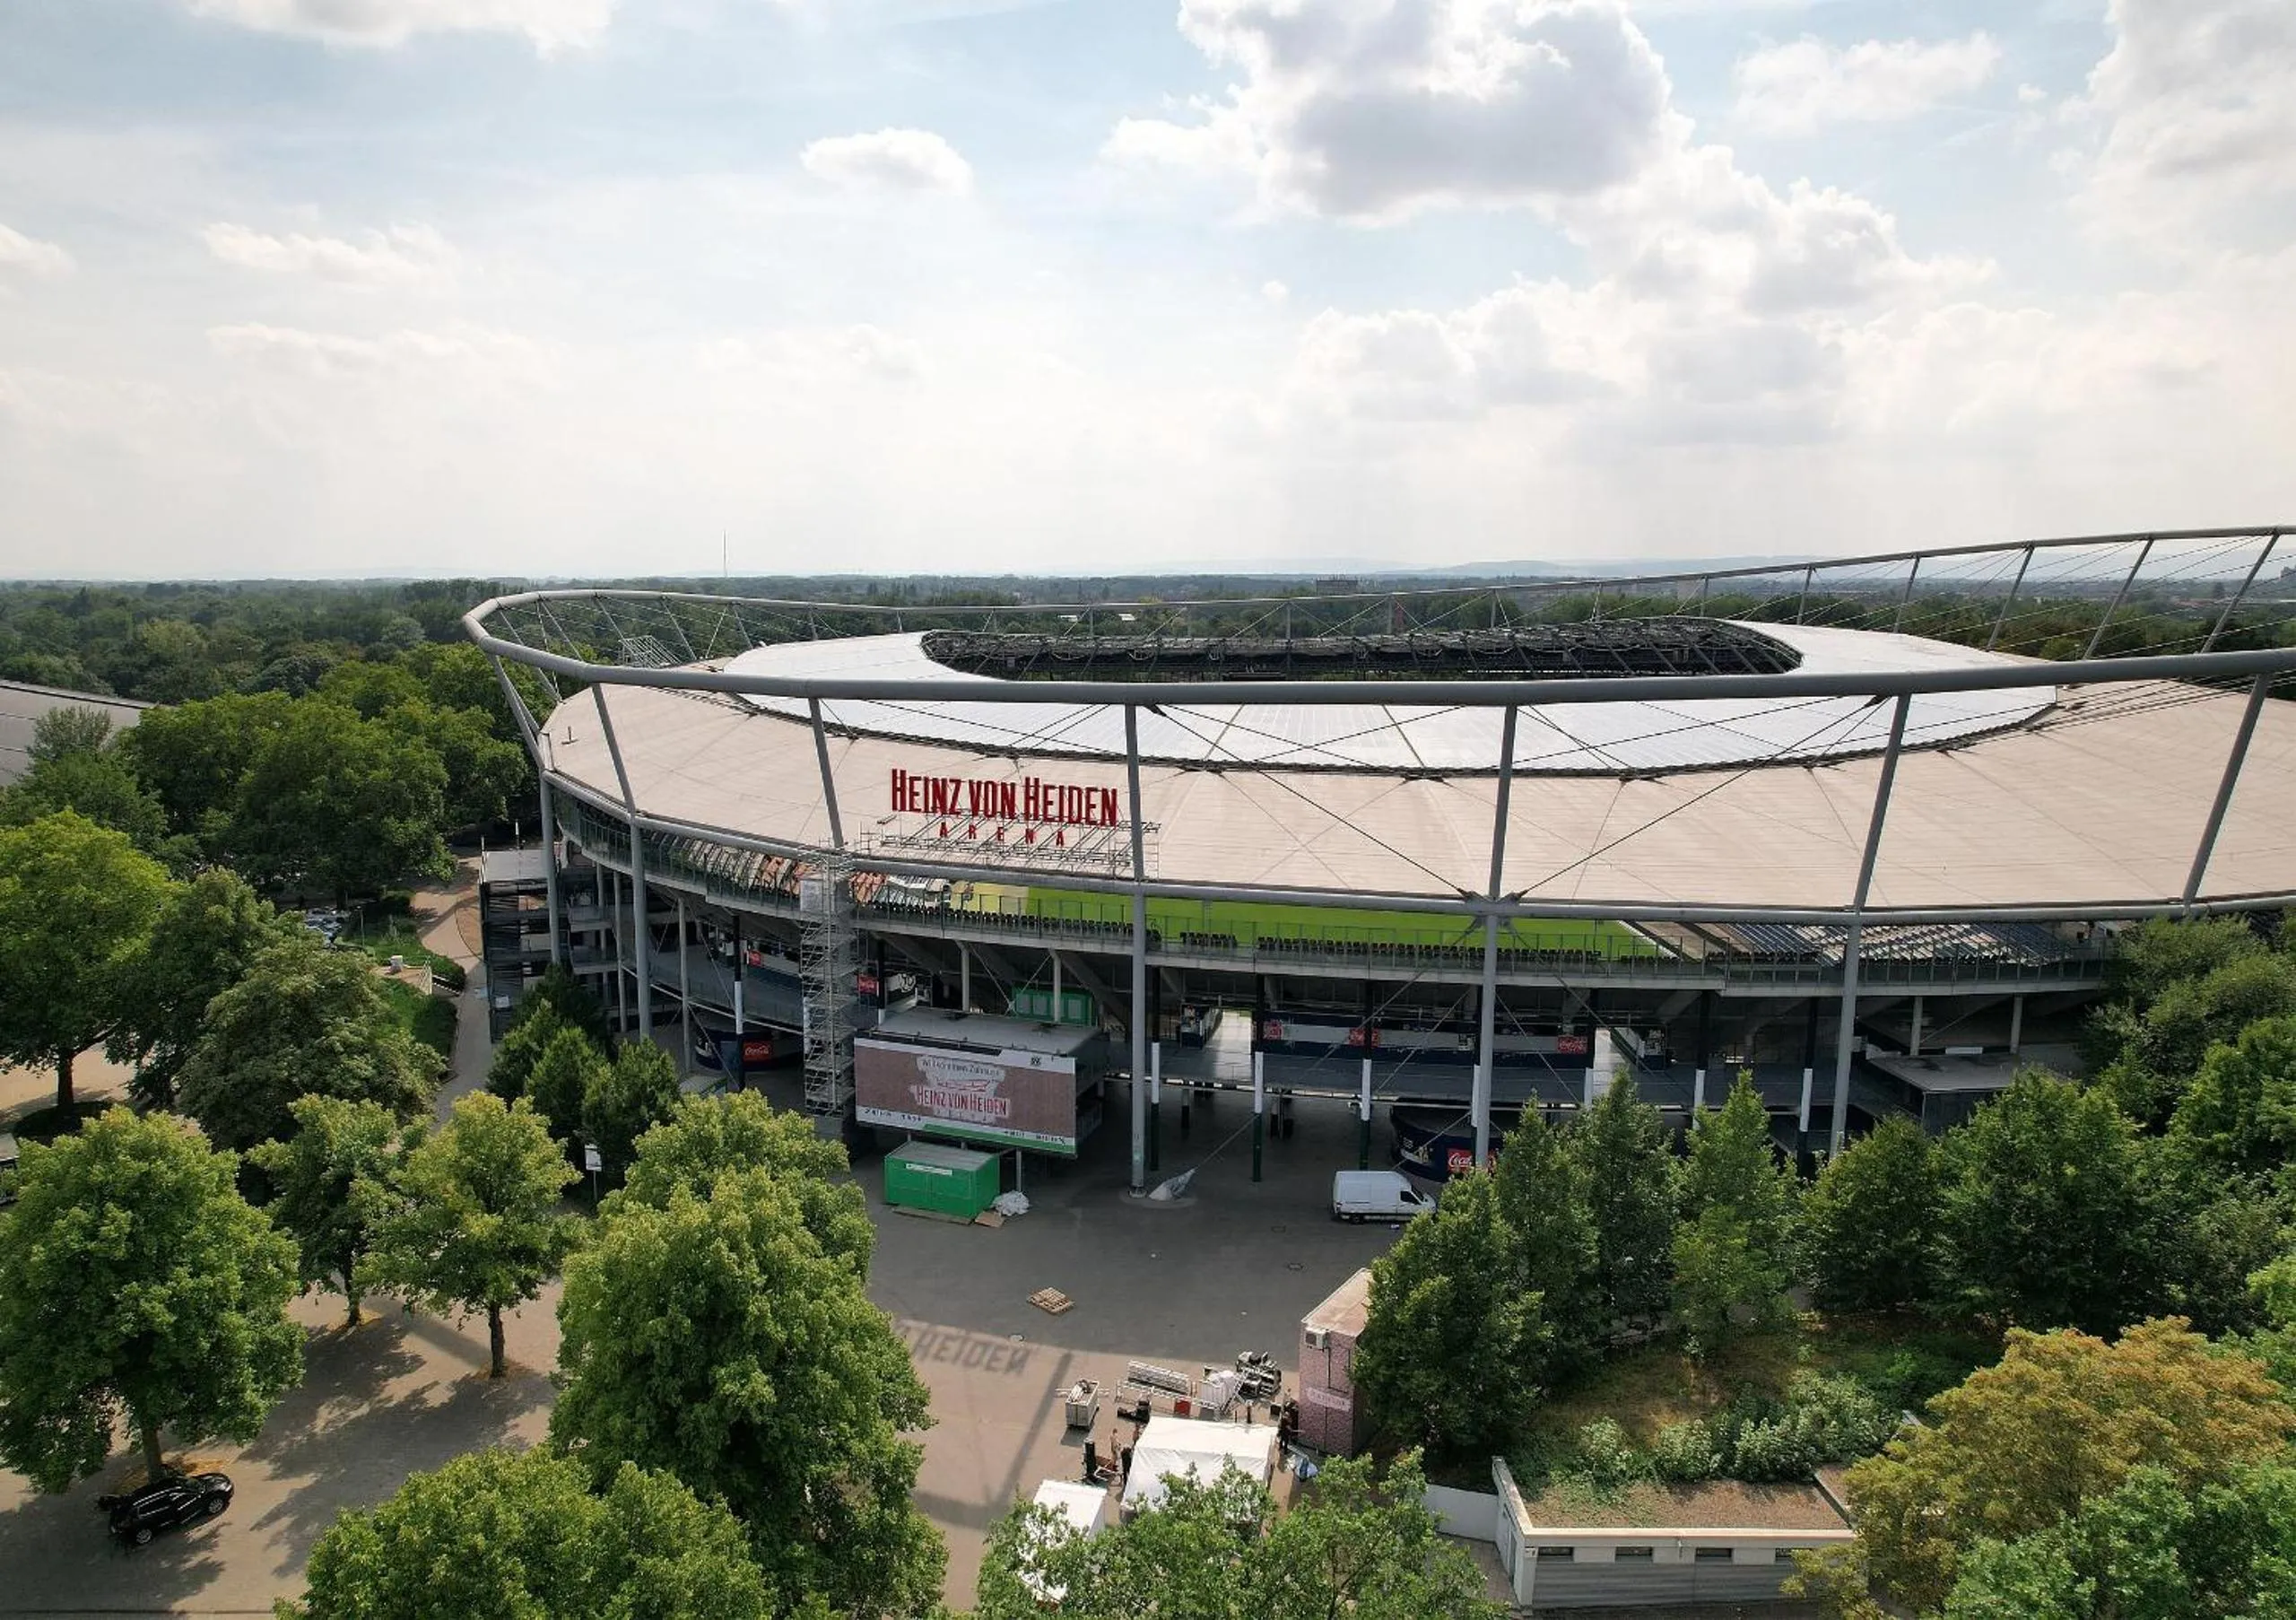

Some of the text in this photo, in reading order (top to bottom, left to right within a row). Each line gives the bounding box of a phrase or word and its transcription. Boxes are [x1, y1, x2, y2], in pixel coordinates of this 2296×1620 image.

[891, 769, 1118, 827] HEINZ VON HEIDEN
[940, 822, 1065, 847] ARENA
[917, 1084, 945, 1107] HEINZ
[948, 1092, 969, 1111] VON
[970, 1093, 1007, 1117] HEIDEN
